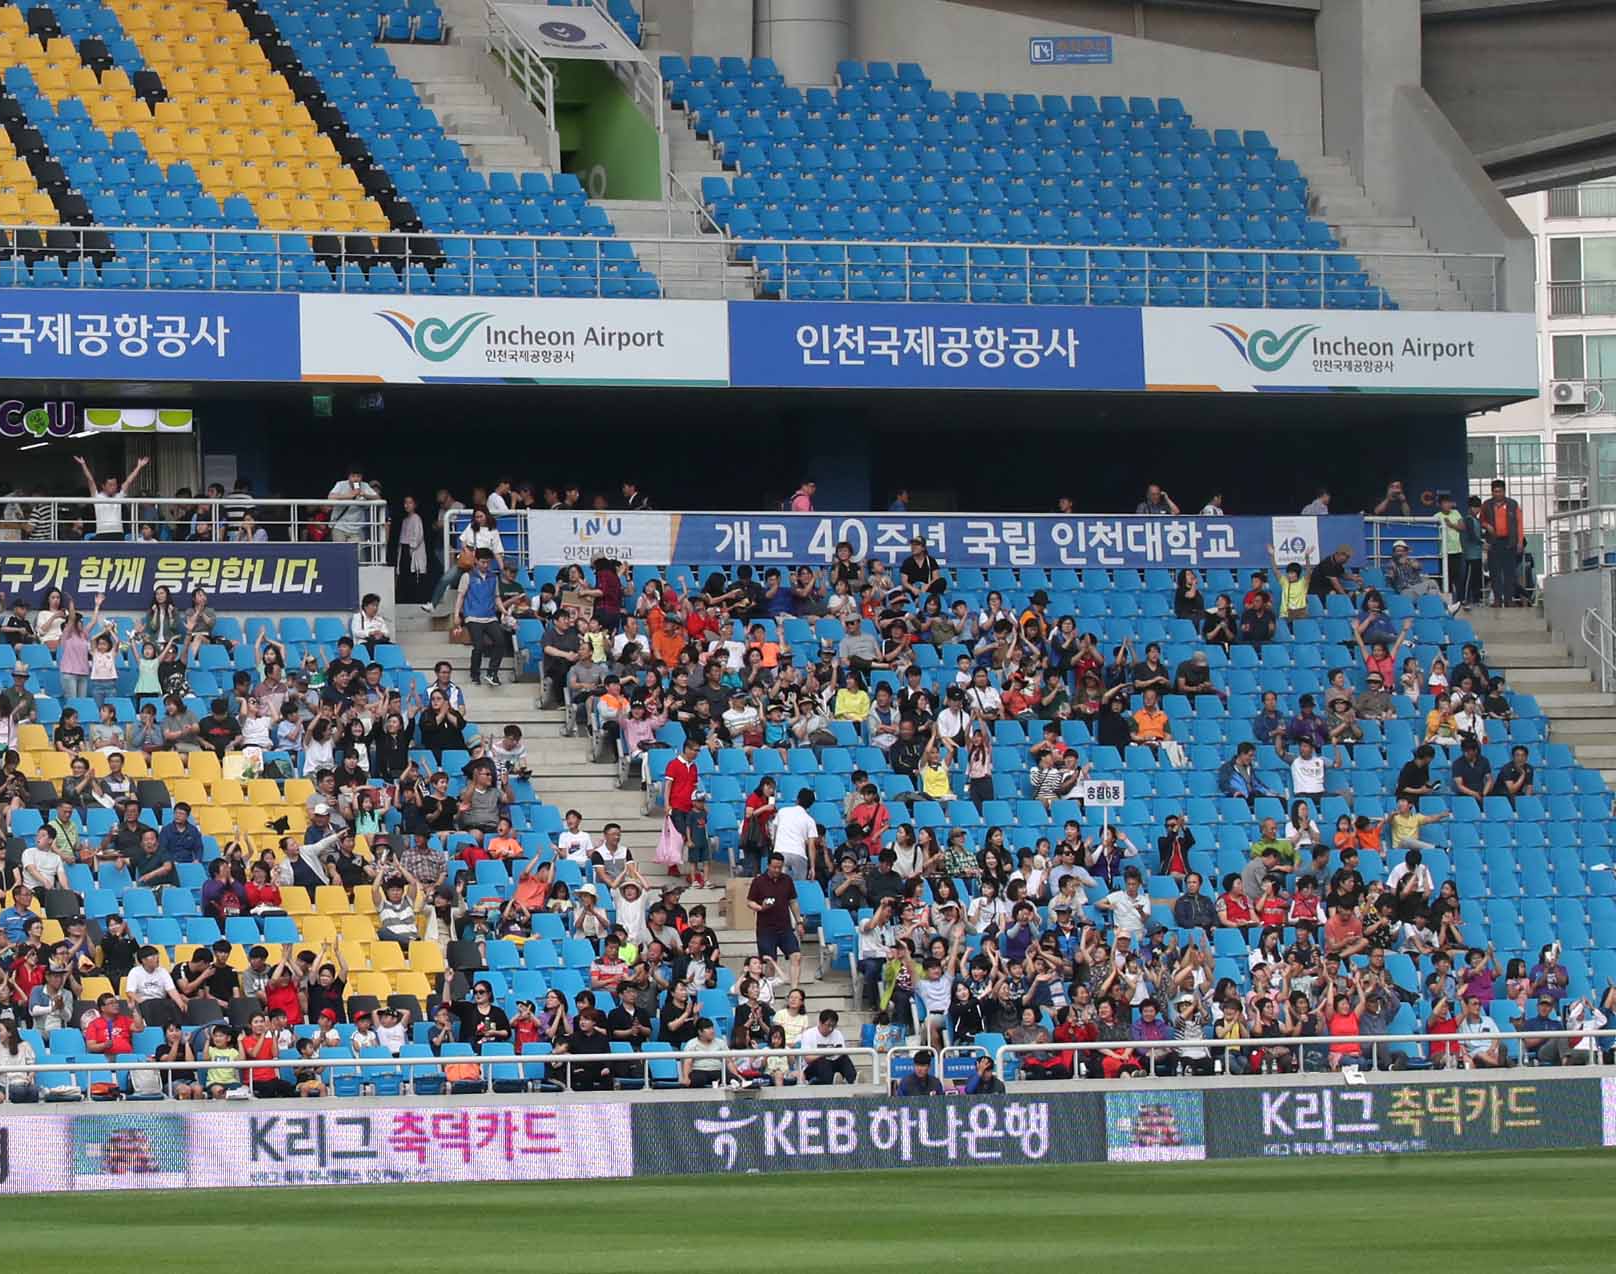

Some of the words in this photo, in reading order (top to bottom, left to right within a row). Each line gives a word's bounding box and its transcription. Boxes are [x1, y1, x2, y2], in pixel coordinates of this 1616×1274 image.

[486, 324, 575, 346] Incheon
[583, 325, 665, 352] Airport
[796, 323, 1080, 369] 인천국제공항공사
[1312, 335, 1394, 357] Incheon
[1401, 337, 1475, 362] Airport
[485, 349, 575, 364] 인천국제공항공사
[1312, 359, 1394, 374] 인천국제공항공사
[572, 517, 622, 536] INU
[715, 521, 793, 562] 개교
[963, 521, 1035, 565] 국립
[1051, 521, 1241, 565] 인천대학교
[563, 545, 633, 561] 인천대학교
[77, 556, 146, 594] 함께
[152, 557, 323, 595] 응원합니다.
[1261, 1089, 1380, 1140] K리그
[1387, 1085, 1541, 1136] 축덕카드
[249, 1114, 378, 1168] K리그
[388, 1111, 563, 1165] 축덕카드
[763, 1110, 858, 1157] KEB
[869, 1102, 1051, 1161] 하나은행
